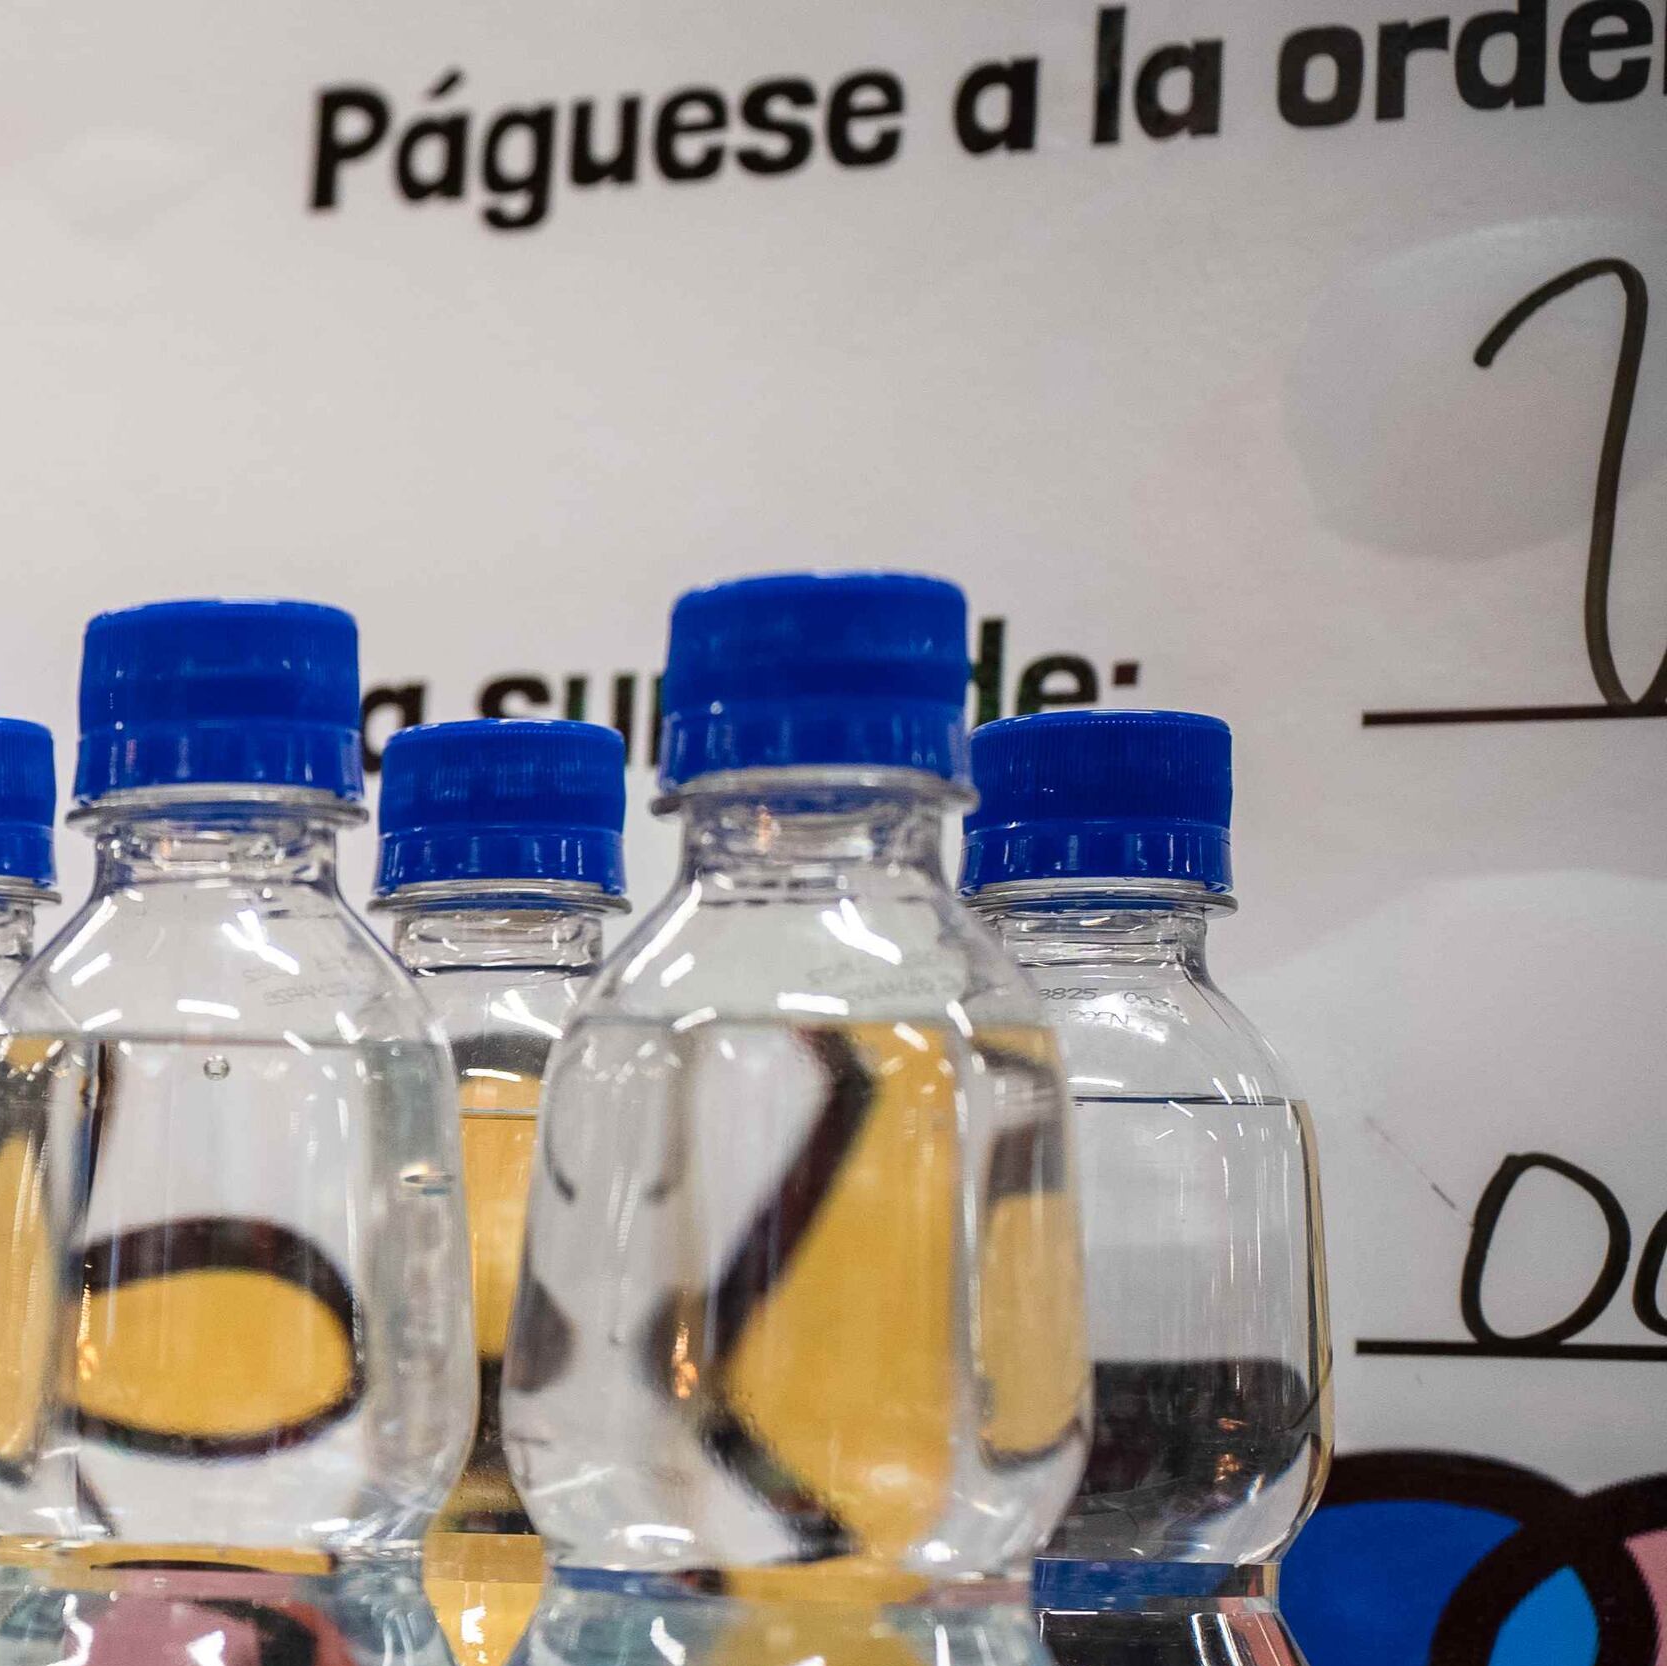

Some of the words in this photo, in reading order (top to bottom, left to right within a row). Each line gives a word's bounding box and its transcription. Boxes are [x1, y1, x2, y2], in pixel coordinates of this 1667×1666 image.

[309, 67, 905, 230] Páguese
[953, 58, 1040, 154] a
[1092, 6, 1223, 144] la
[1276, 0, 1667, 127] orde
